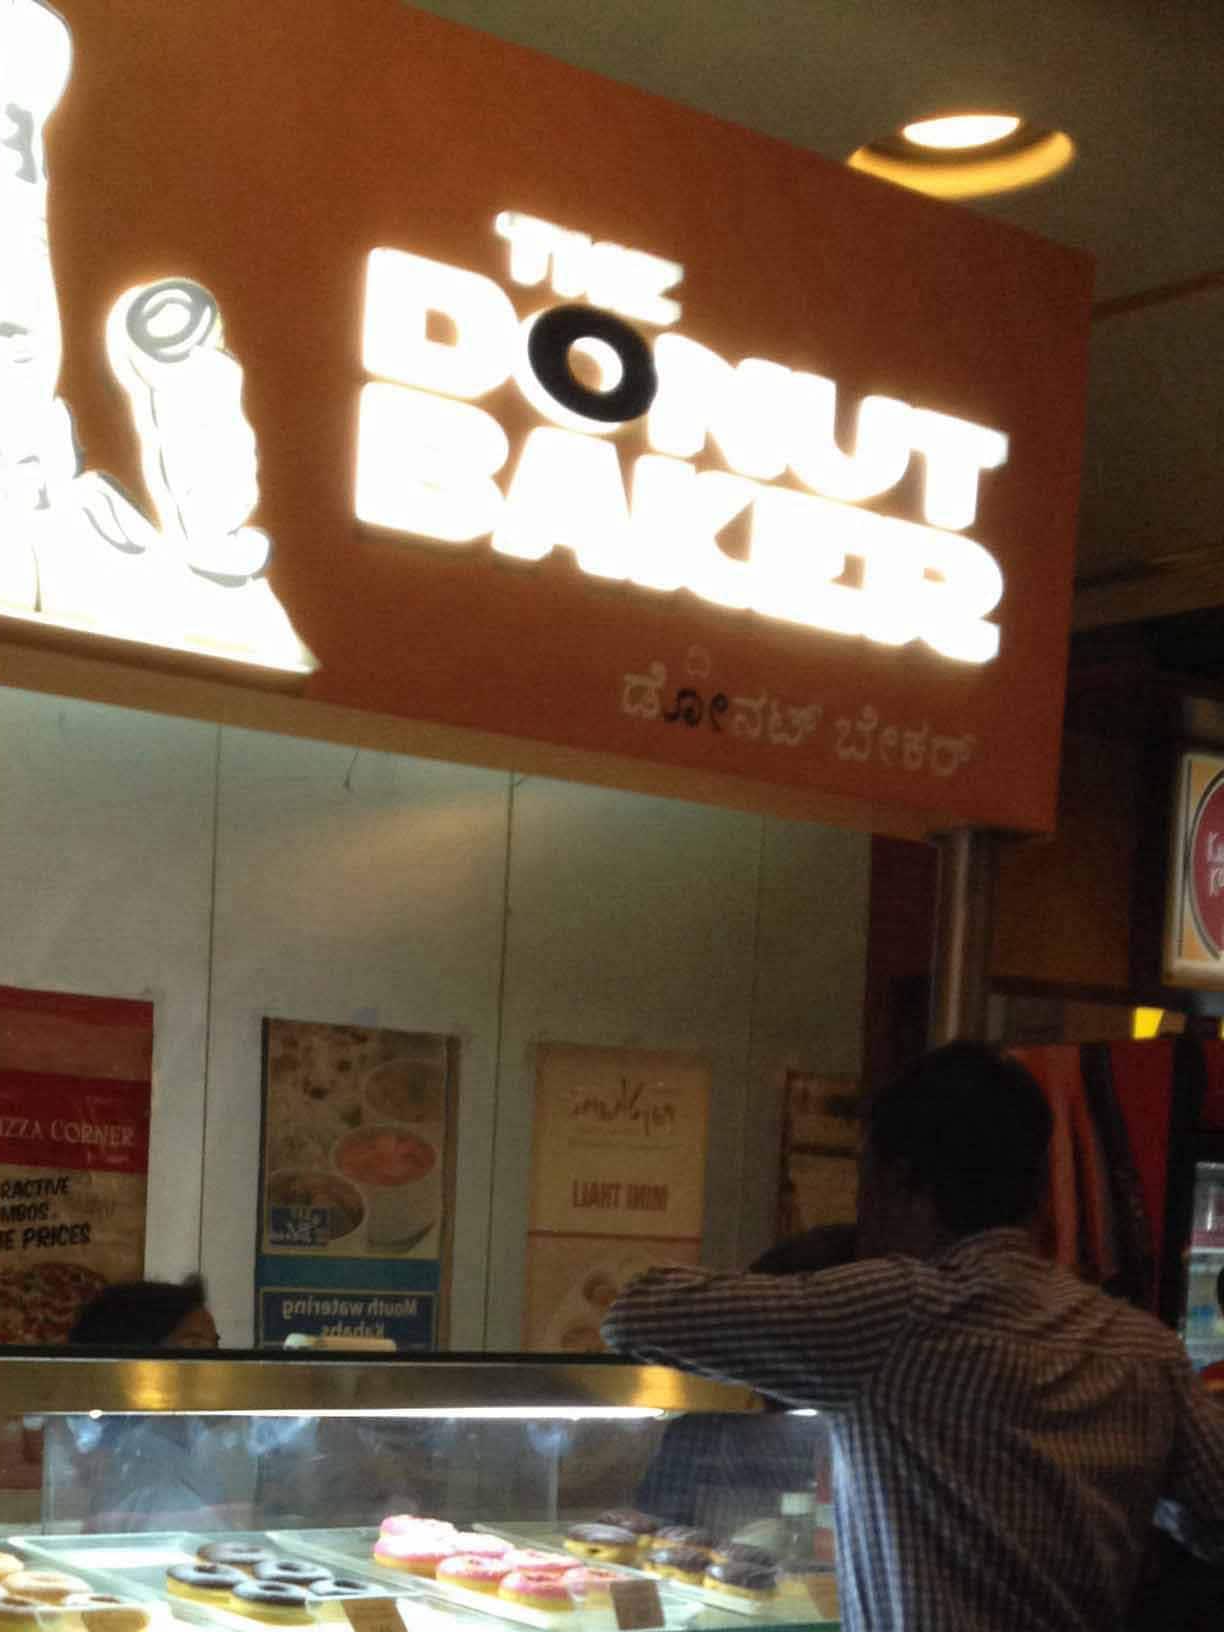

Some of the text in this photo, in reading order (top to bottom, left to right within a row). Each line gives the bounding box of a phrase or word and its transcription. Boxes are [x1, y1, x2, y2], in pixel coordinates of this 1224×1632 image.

[494, 209, 684, 326] THE
[361, 246, 1010, 532] DONUT
[353, 381, 1006, 666] BAKER
[50, 1119, 136, 1147] CORNER
[22, 1222, 92, 1250] PRICES
